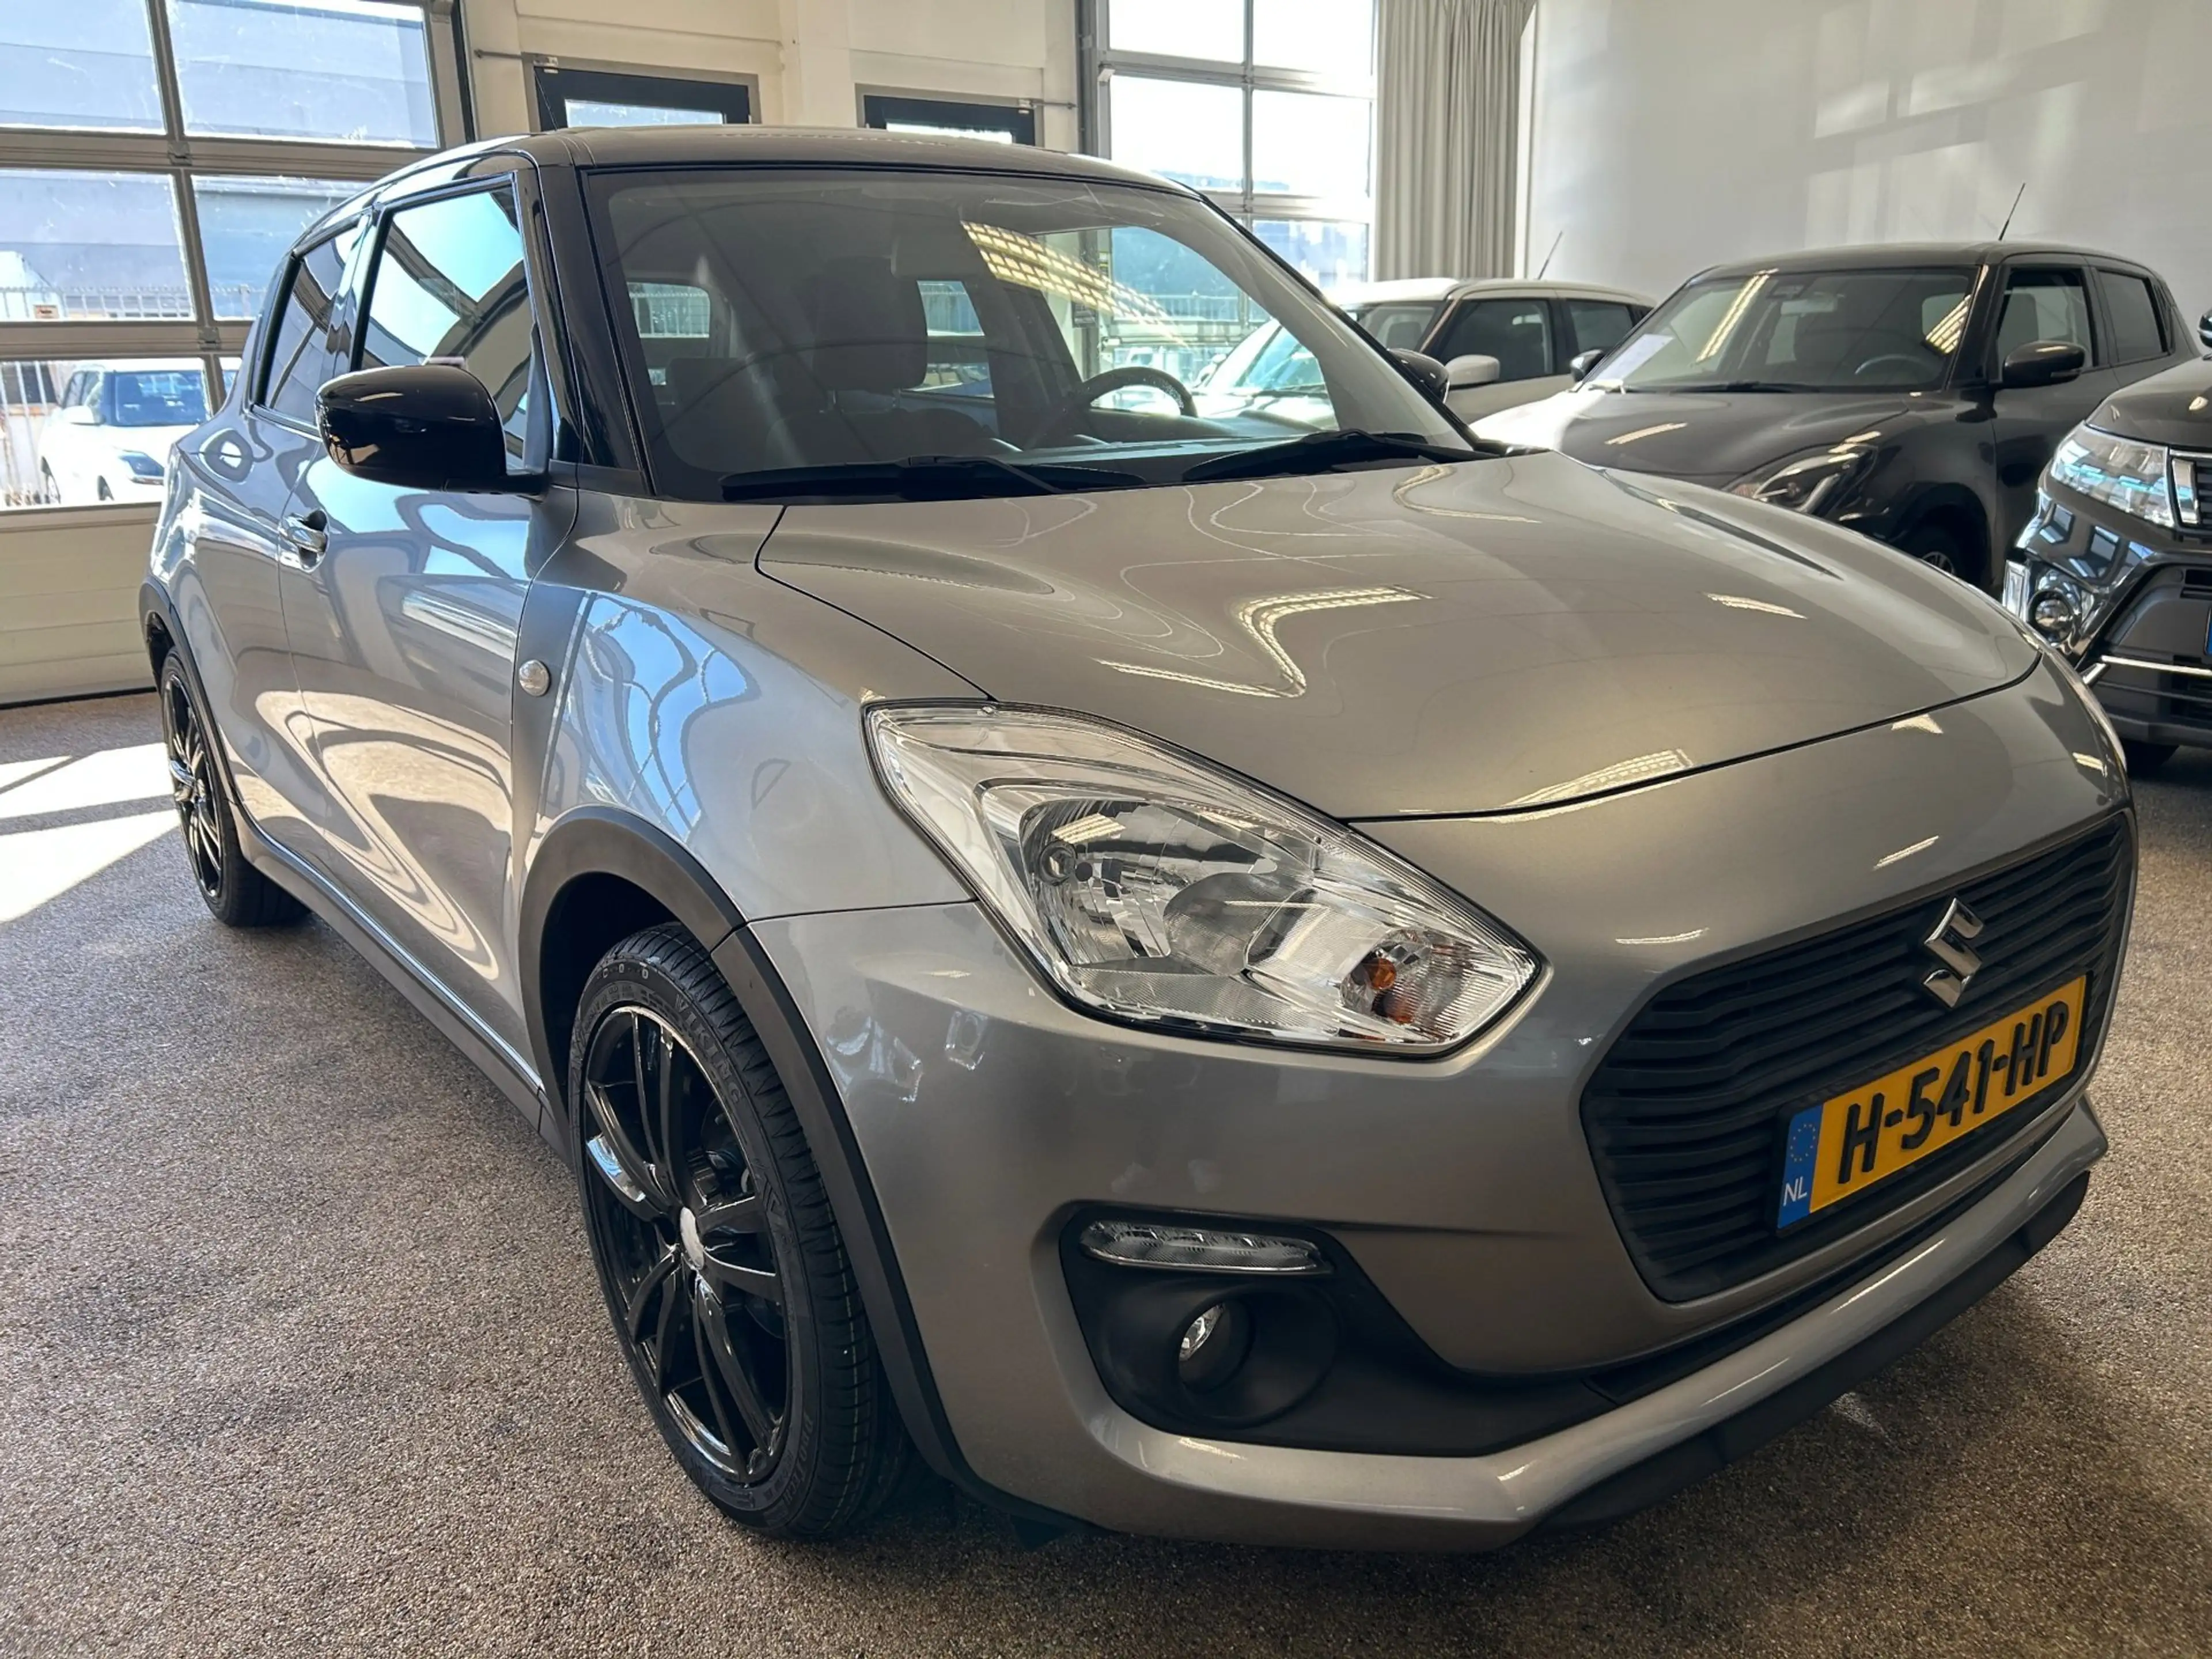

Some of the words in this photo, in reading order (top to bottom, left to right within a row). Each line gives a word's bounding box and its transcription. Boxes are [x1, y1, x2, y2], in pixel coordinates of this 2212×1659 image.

[676, 994, 743, 1103] VIKING
[1838, 1001, 2069, 1184] H-541-HP
[1783, 1177, 1807, 1205] NL
